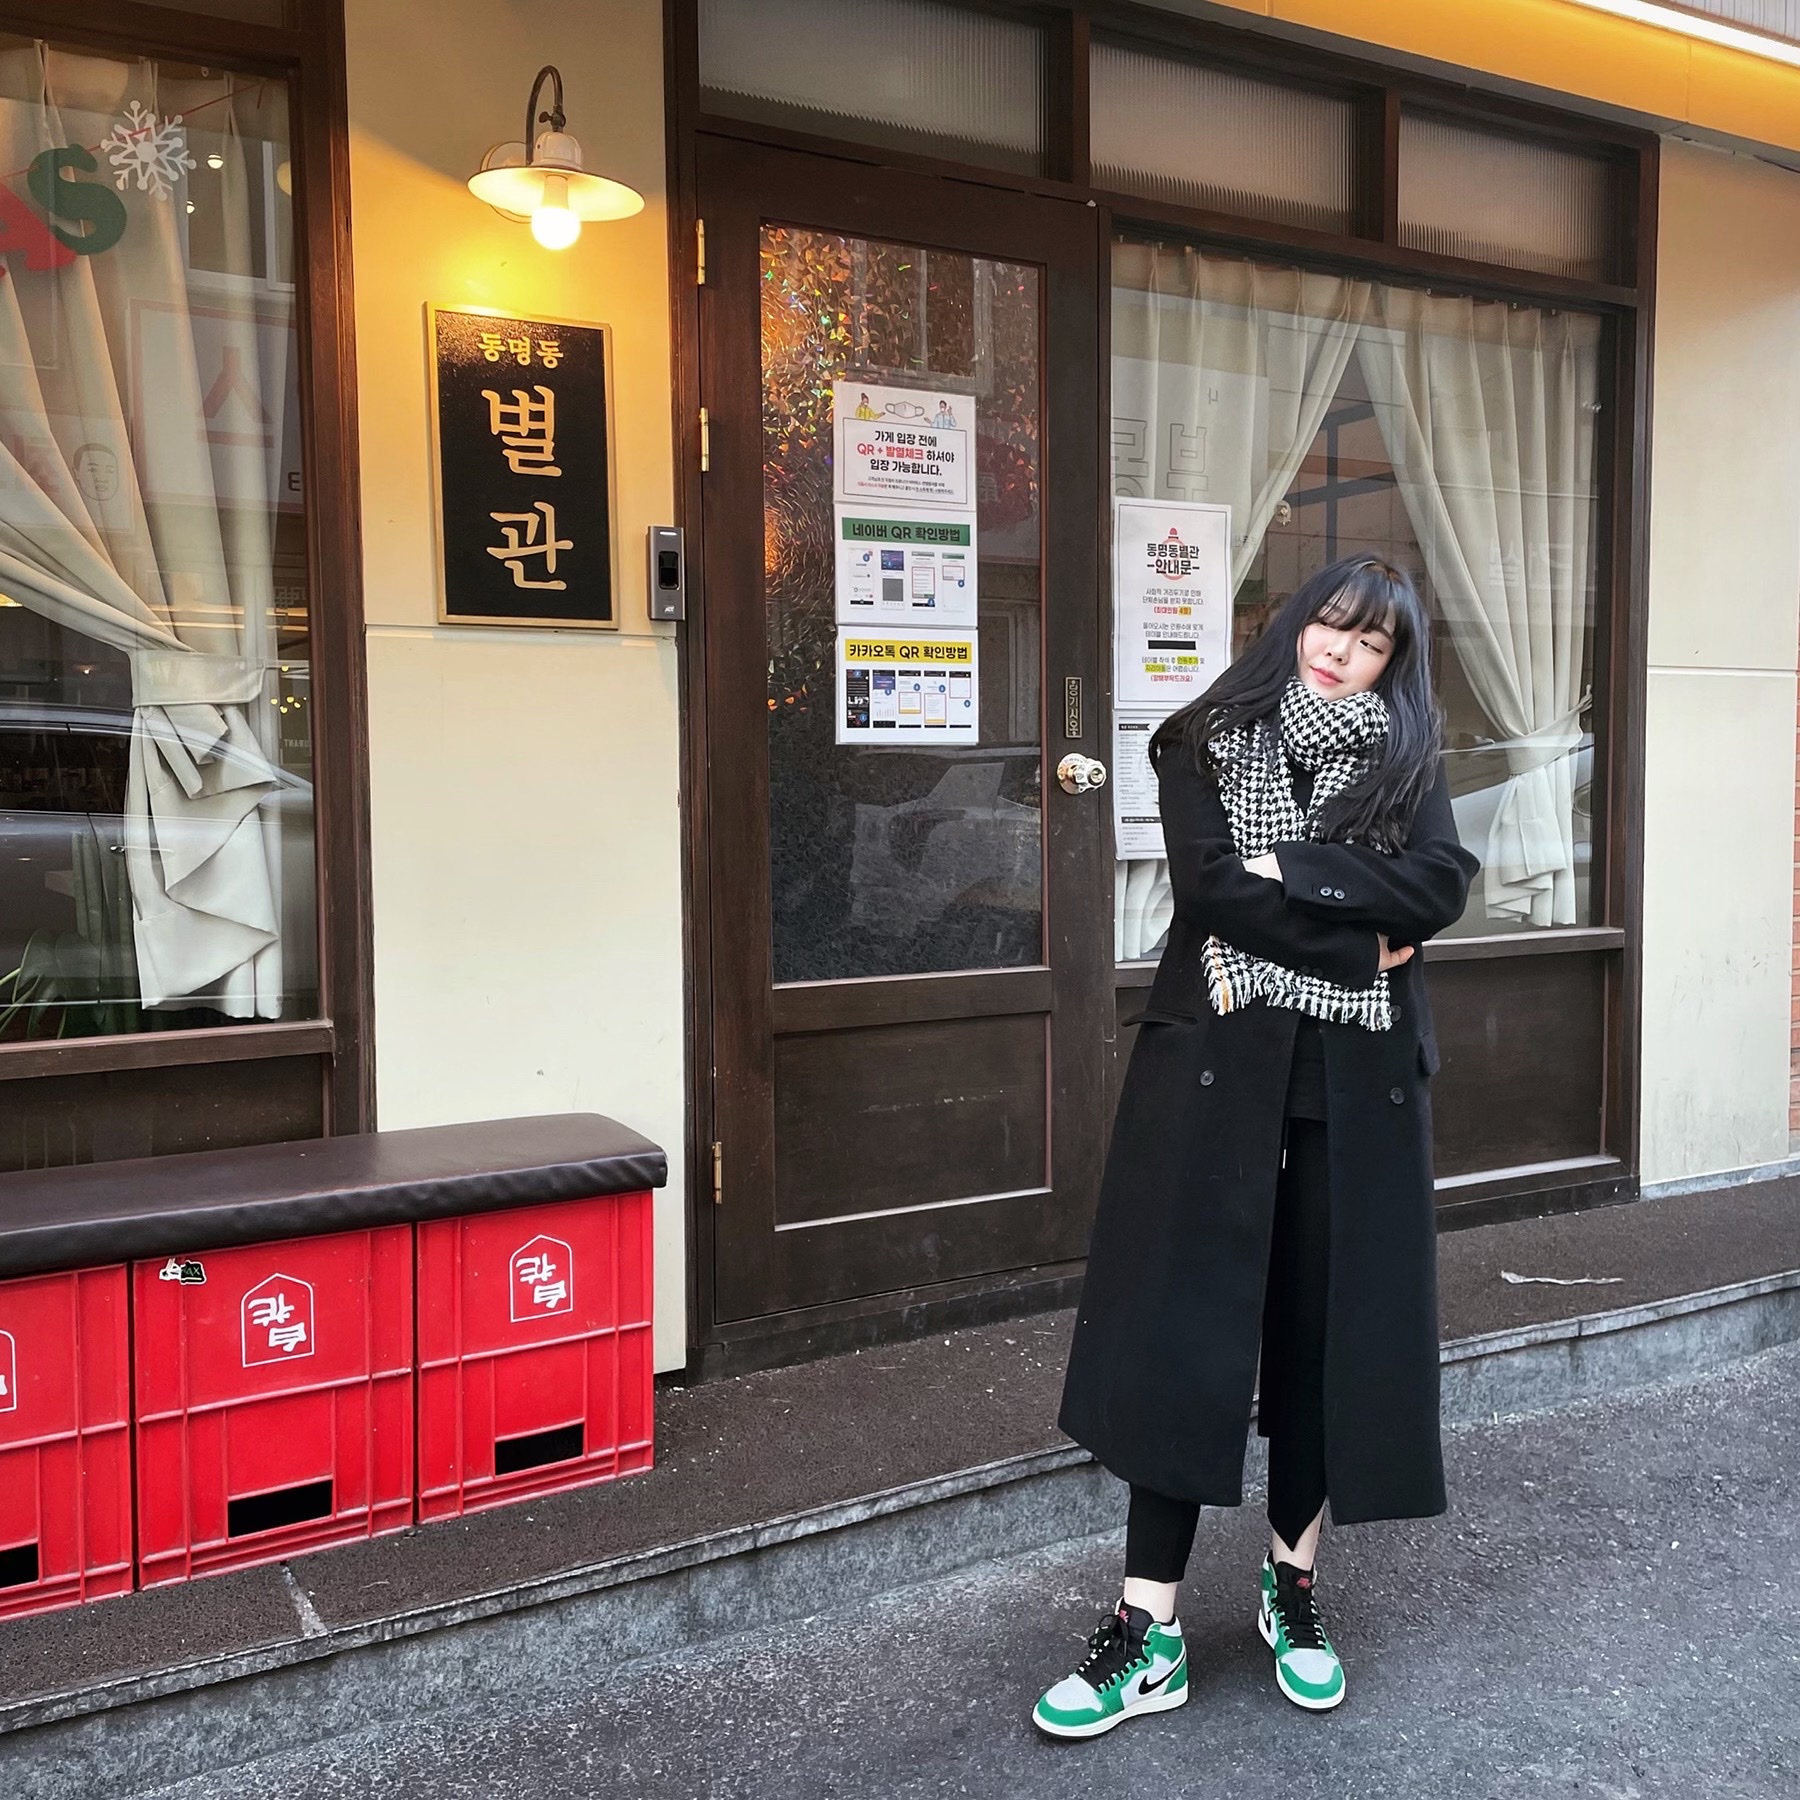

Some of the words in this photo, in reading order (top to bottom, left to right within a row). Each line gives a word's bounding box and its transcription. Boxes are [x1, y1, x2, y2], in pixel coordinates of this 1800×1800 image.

[478, 331, 563, 369] 동명동
[875, 430, 894, 443] 가게
[897, 432, 916, 446] 입장
[918, 434, 937, 448] 전에
[857, 443, 874, 456] QR
[886, 445, 924, 460] 발열체크
[926, 450, 954, 463] 하셔야
[870, 458, 889, 472] 입장
[892, 460, 942, 476] 가능합니다.
[481, 384, 574, 591] 별관
[852, 524, 887, 538] 네이버
[890, 526, 912, 539] QR
[915, 526, 960, 542] 확인방법
[1147, 544, 1200, 559] 동명동별관
[850, 644, 895, 658] 카카오톡
[900, 646, 920, 659] QR
[923, 646, 968, 660] 확인방법
